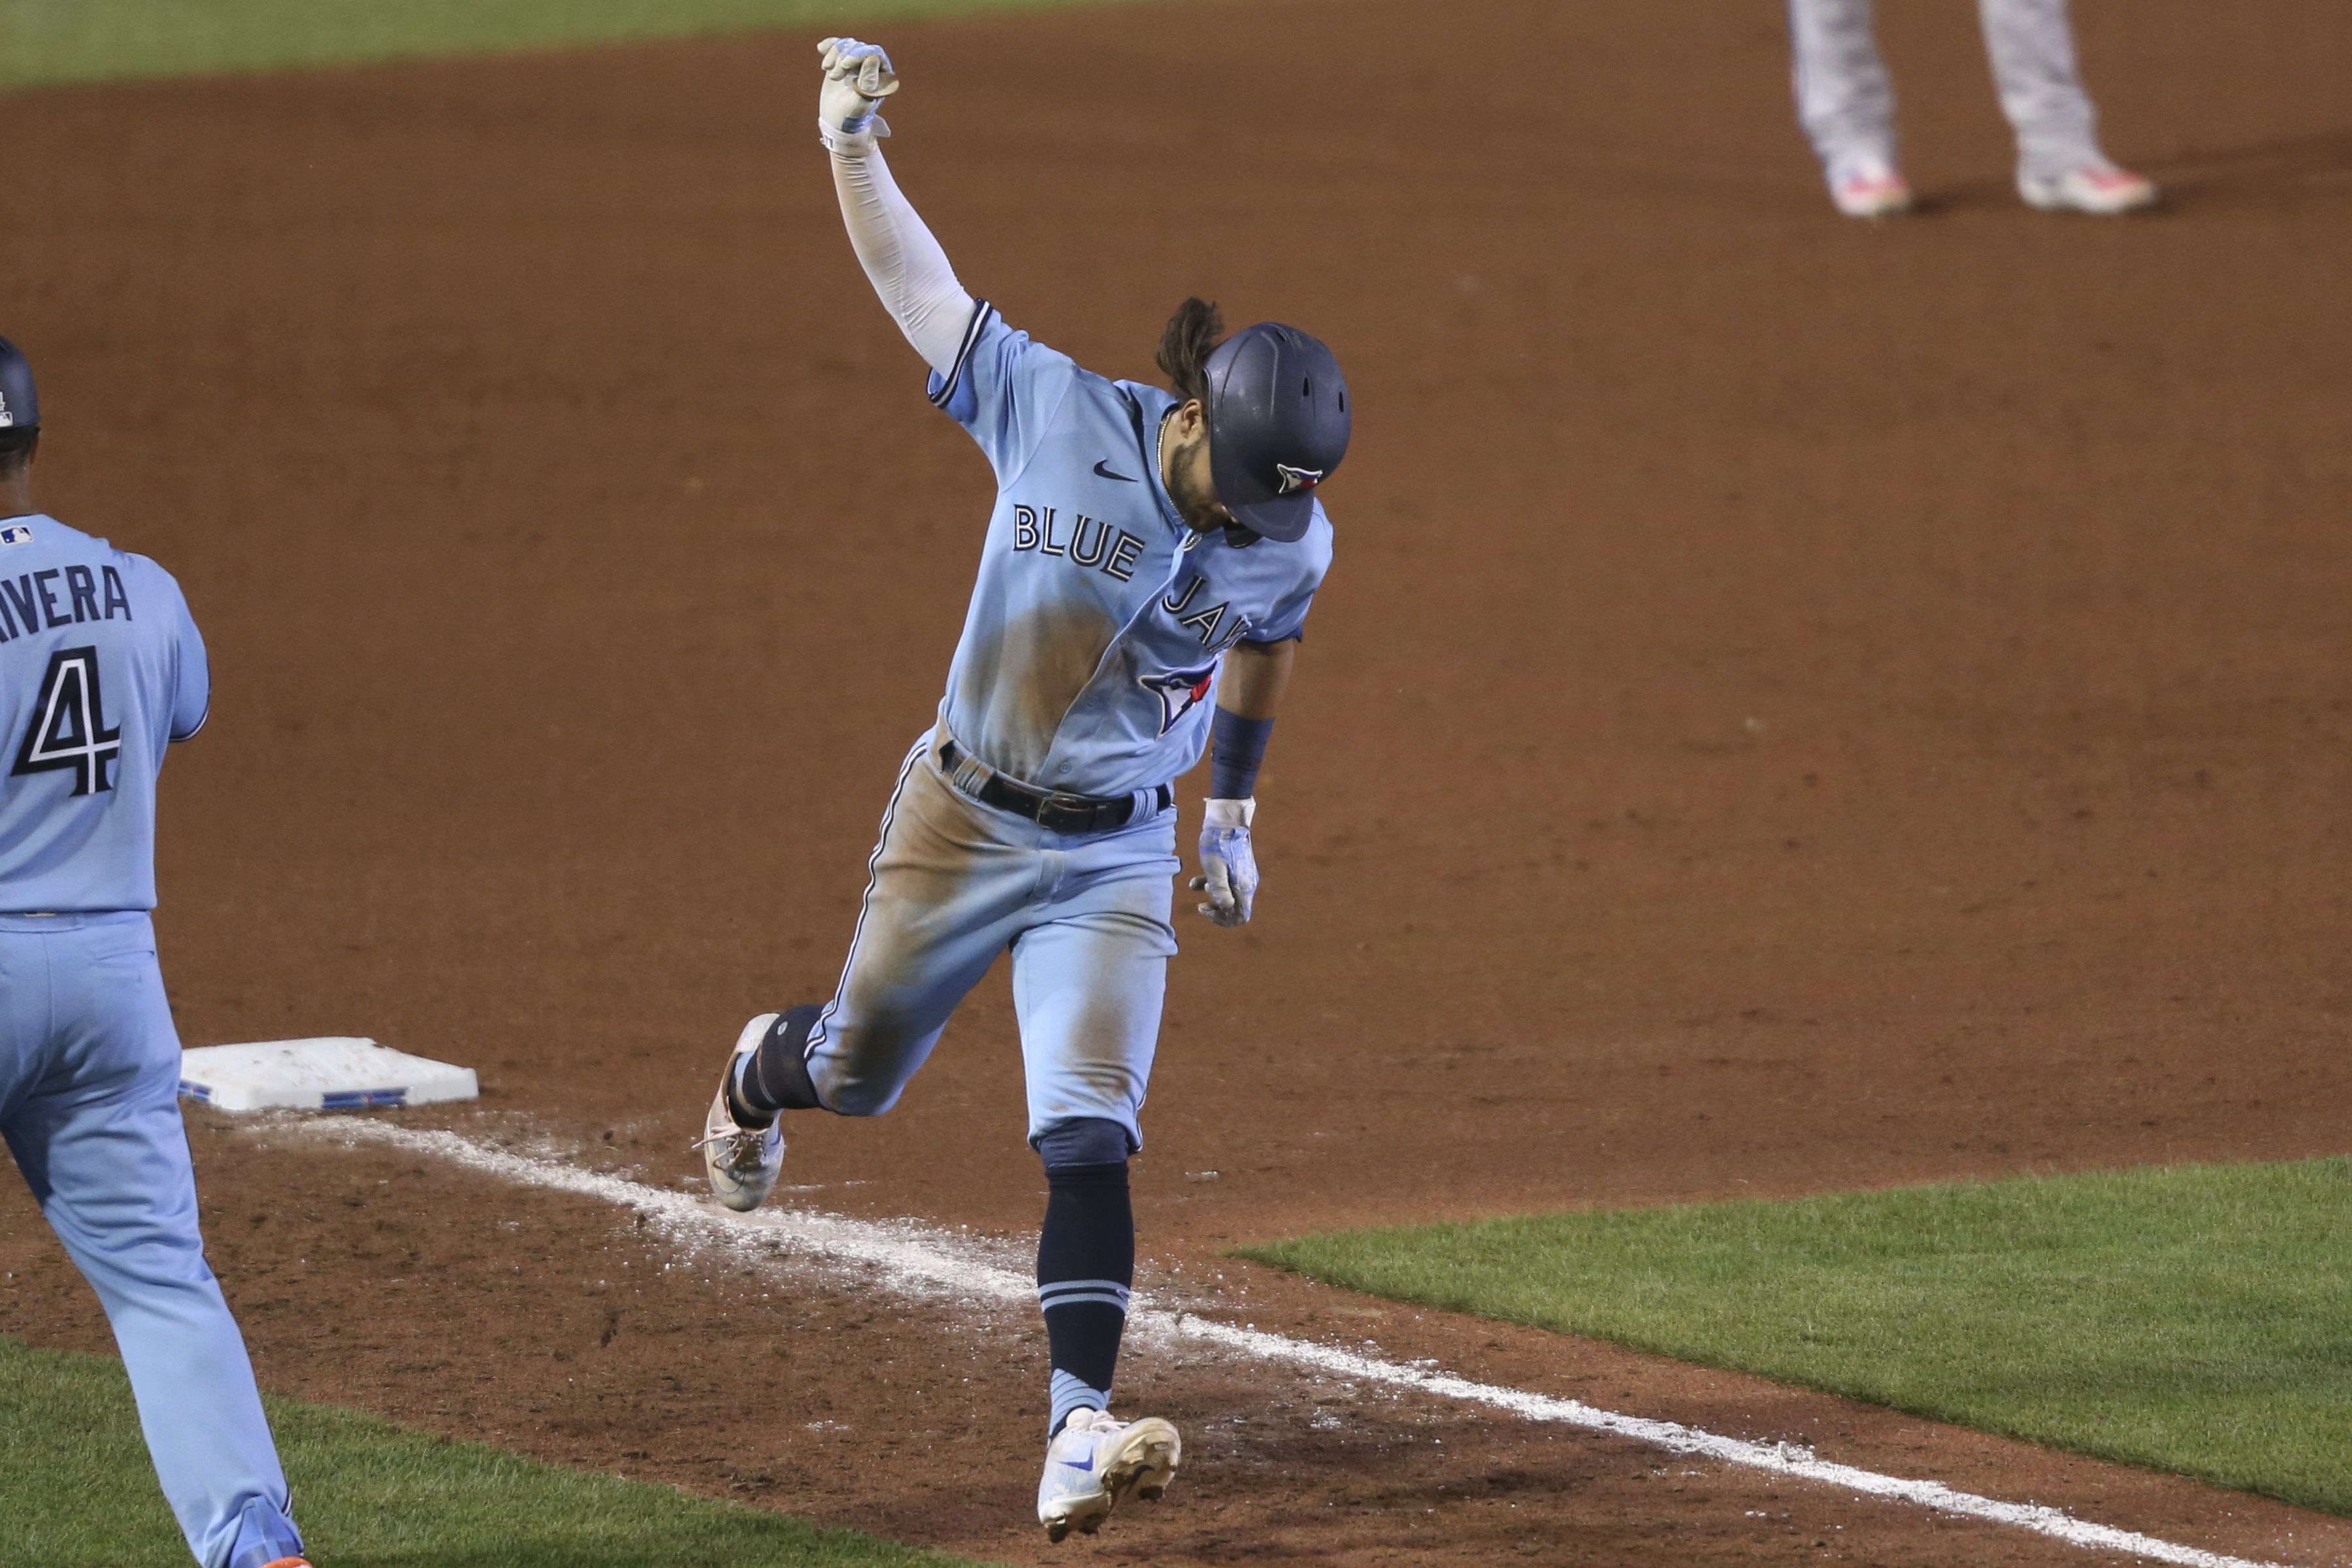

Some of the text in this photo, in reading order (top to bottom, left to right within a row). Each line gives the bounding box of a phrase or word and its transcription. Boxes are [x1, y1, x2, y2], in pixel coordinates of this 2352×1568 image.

[1013, 504, 1145, 583] BLUE
[0, 564, 133, 643] IVERA
[10, 645, 122, 798] 4
